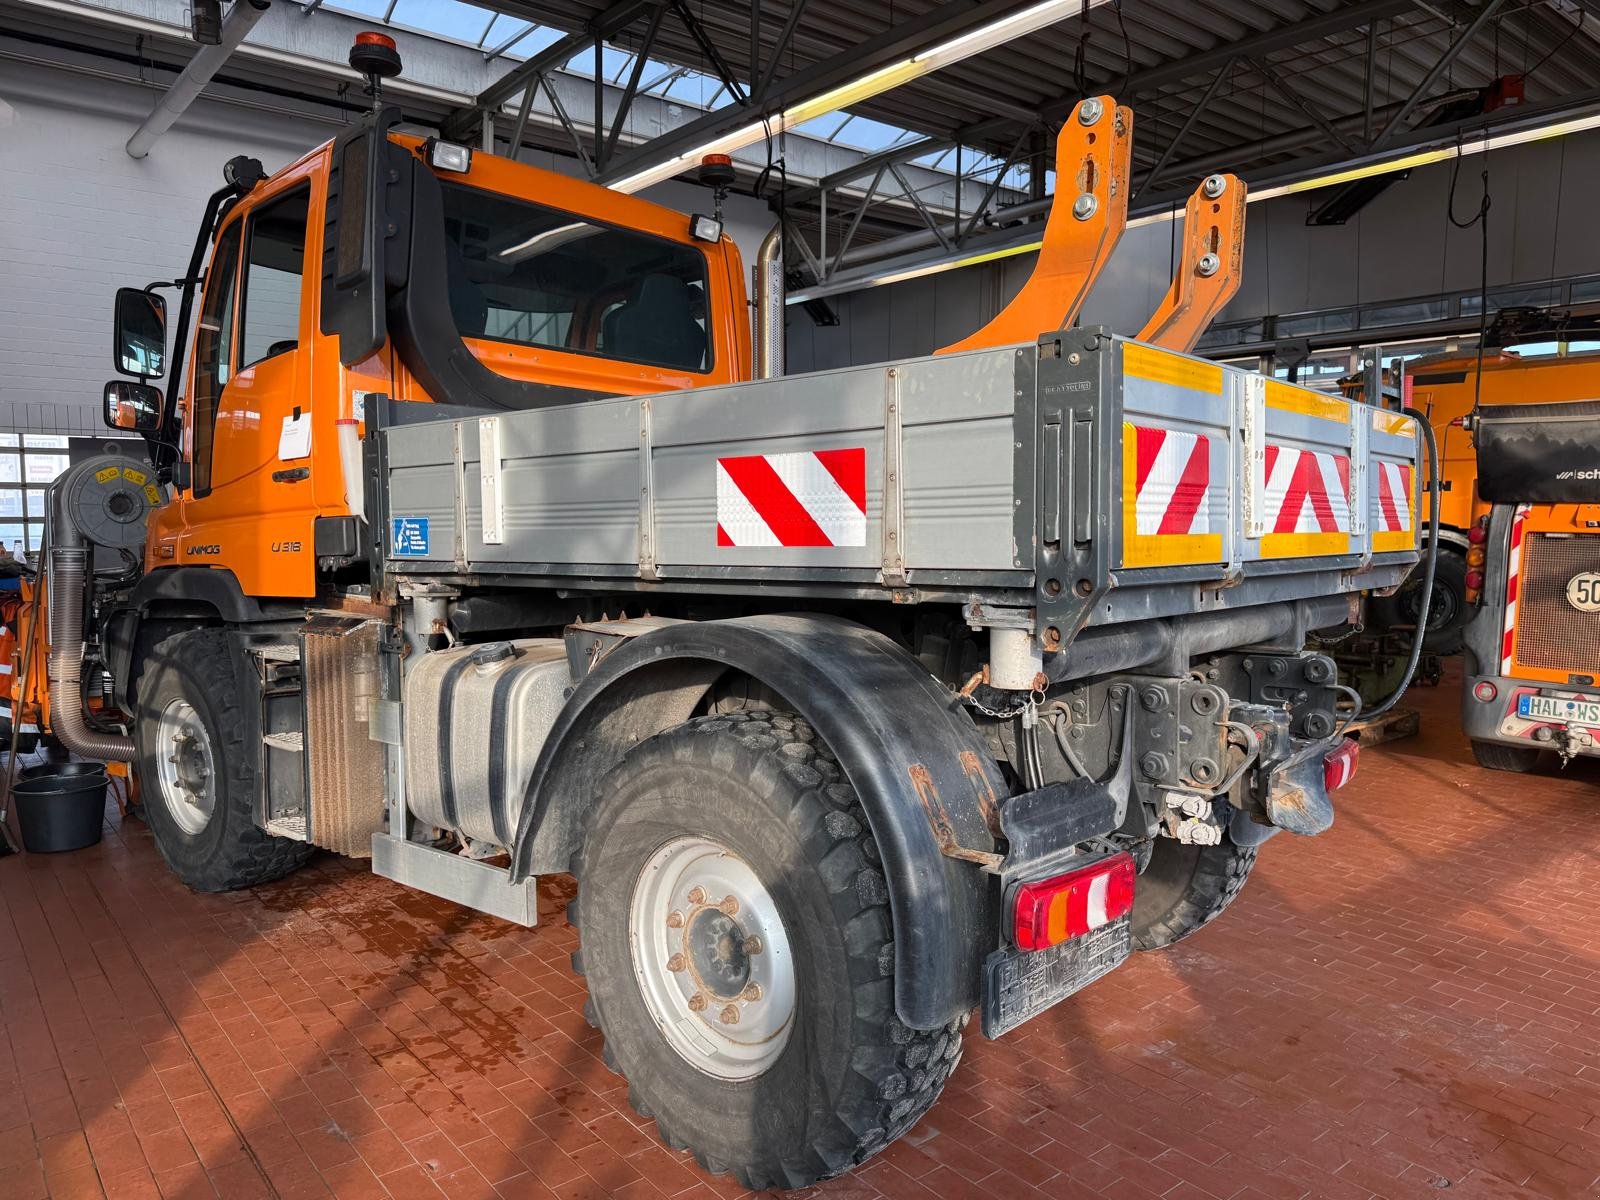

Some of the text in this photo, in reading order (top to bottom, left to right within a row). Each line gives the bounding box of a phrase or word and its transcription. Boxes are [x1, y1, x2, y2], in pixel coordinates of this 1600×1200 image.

[187, 545, 220, 555] UNIMOG
[271, 542, 281, 552] U
[1577, 580, 1600, 603] 50
[1531, 698, 1563, 717] HAL
